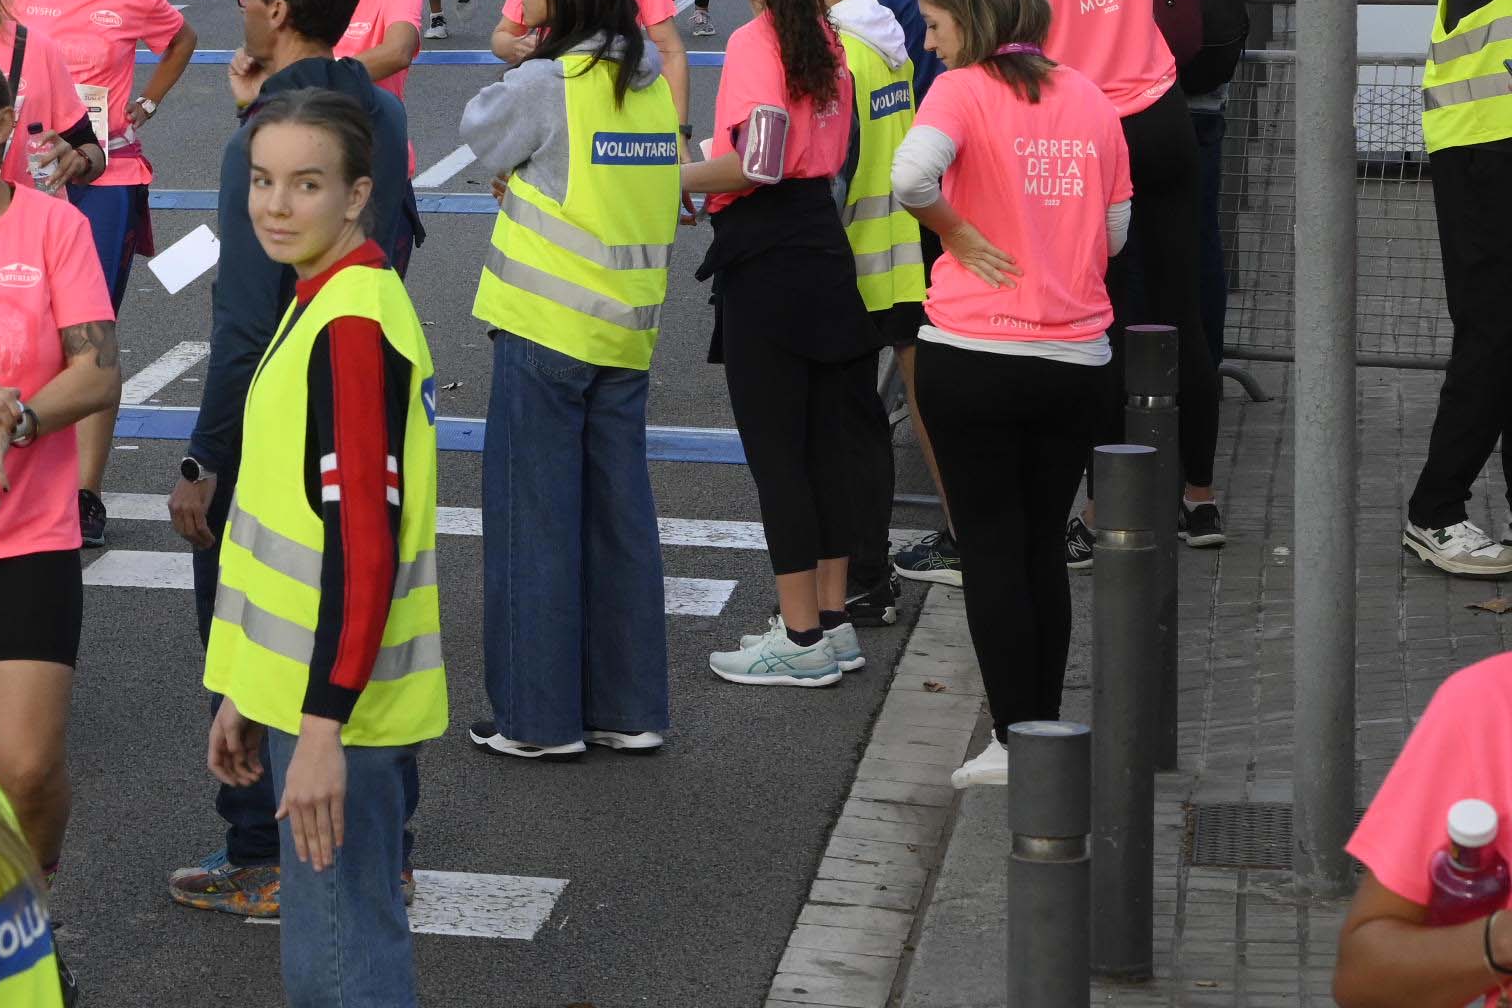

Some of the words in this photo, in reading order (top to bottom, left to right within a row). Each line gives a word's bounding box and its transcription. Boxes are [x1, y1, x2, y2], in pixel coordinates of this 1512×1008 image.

[595, 140, 676, 157] VOLUNTARIS
[1014, 137, 1097, 158] CARRERA
[1027, 158, 1049, 177] DE
[1057, 161, 1081, 177] LA
[1024, 178, 1084, 197] MUJER
[991, 314, 1041, 331] OYSHO
